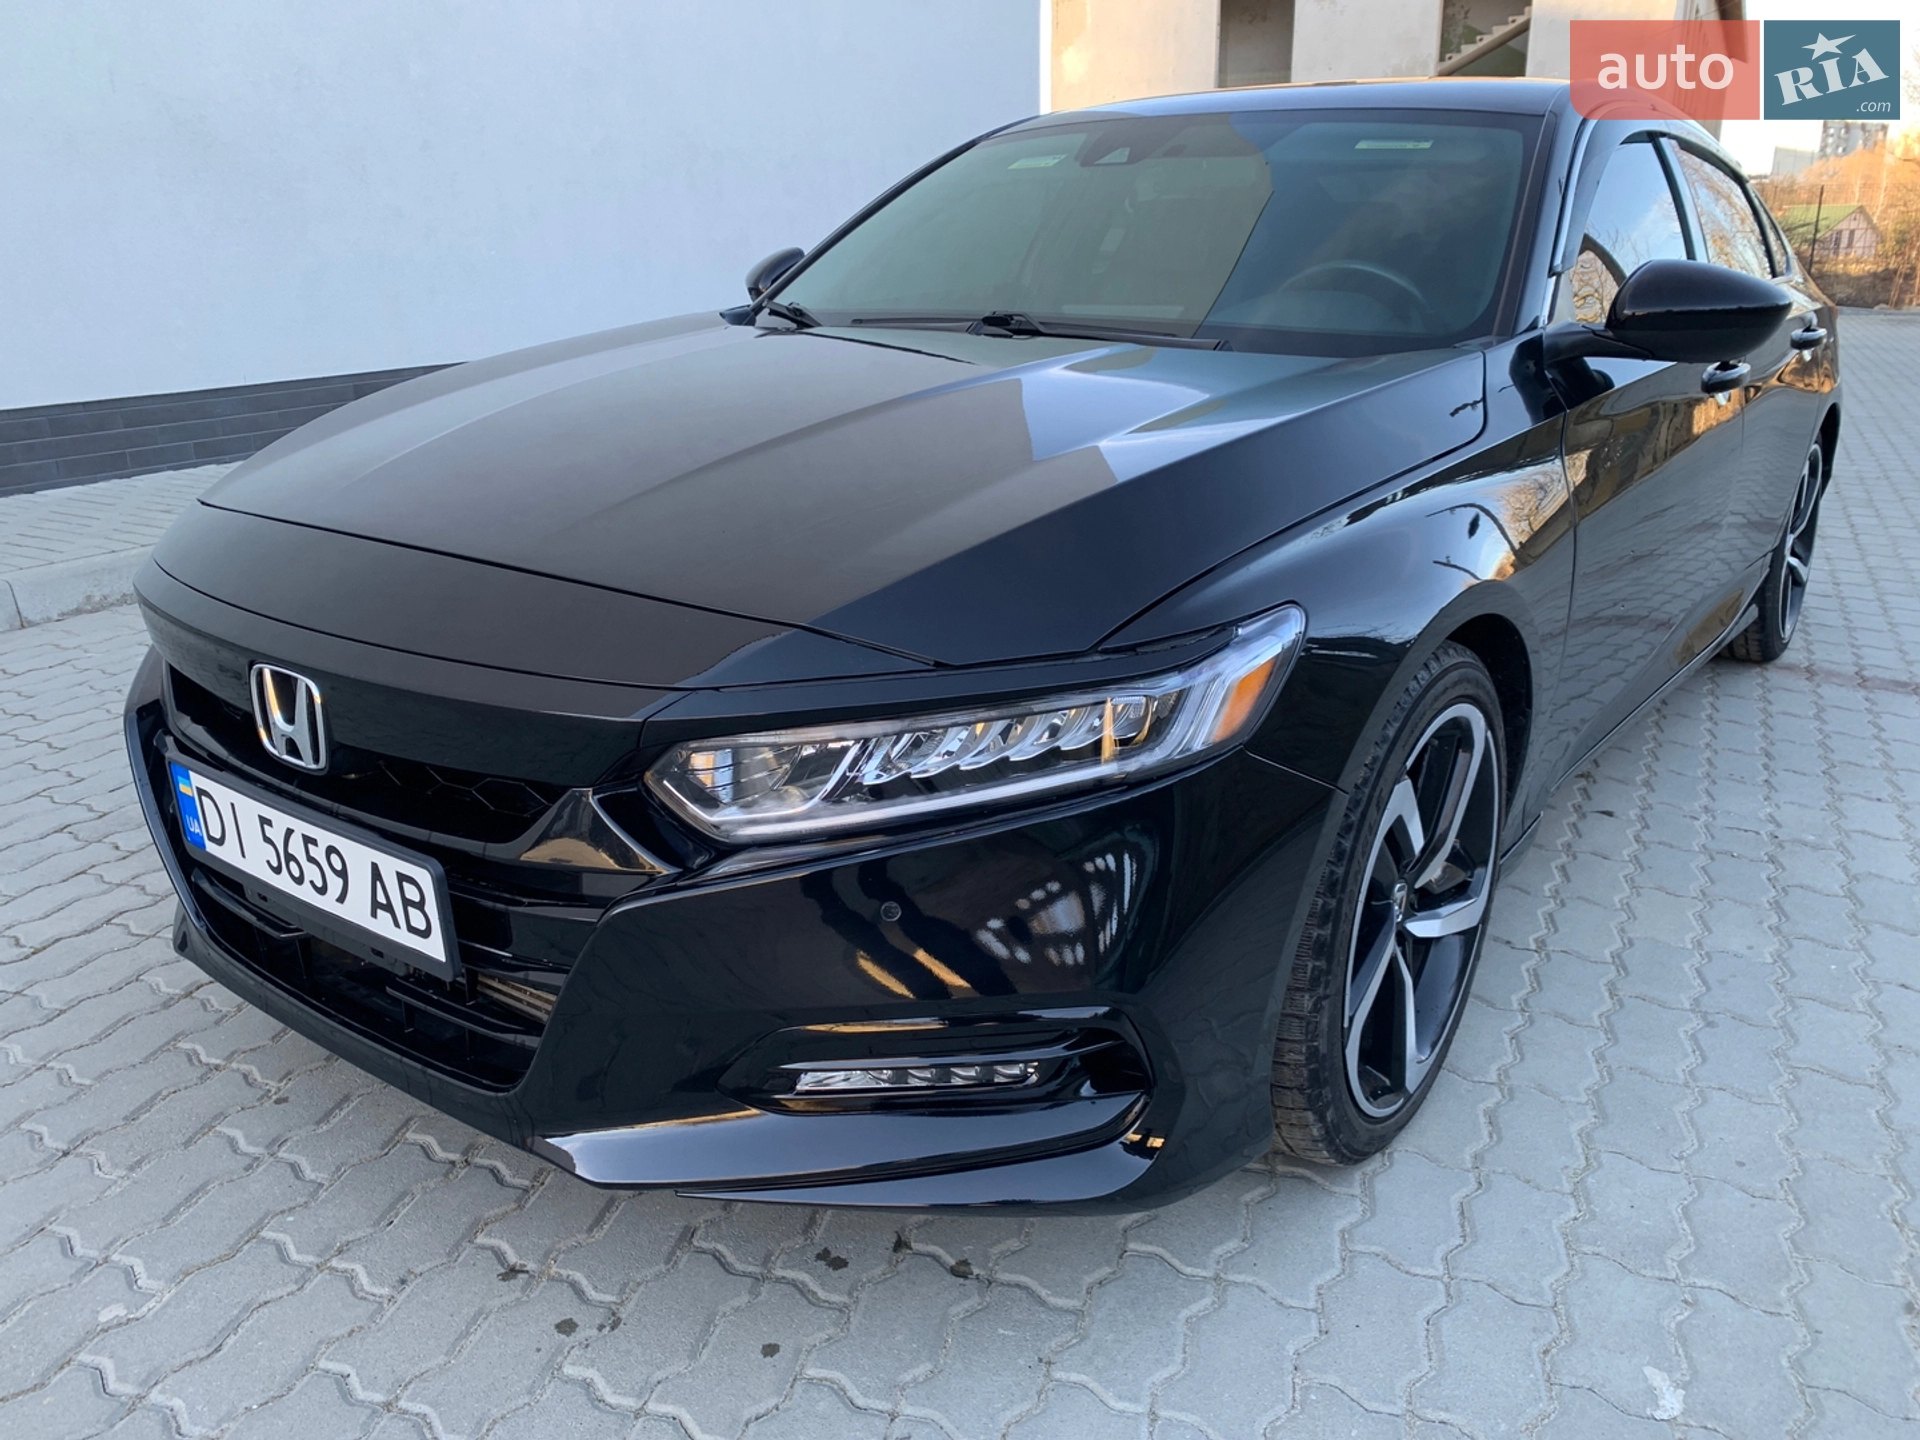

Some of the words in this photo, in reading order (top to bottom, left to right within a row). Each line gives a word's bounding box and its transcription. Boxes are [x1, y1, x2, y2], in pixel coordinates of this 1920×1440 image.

[186, 815, 203, 836] UA
[195, 786, 246, 858] DI
[257, 814, 349, 904] 5659
[370, 861, 432, 939] AB
